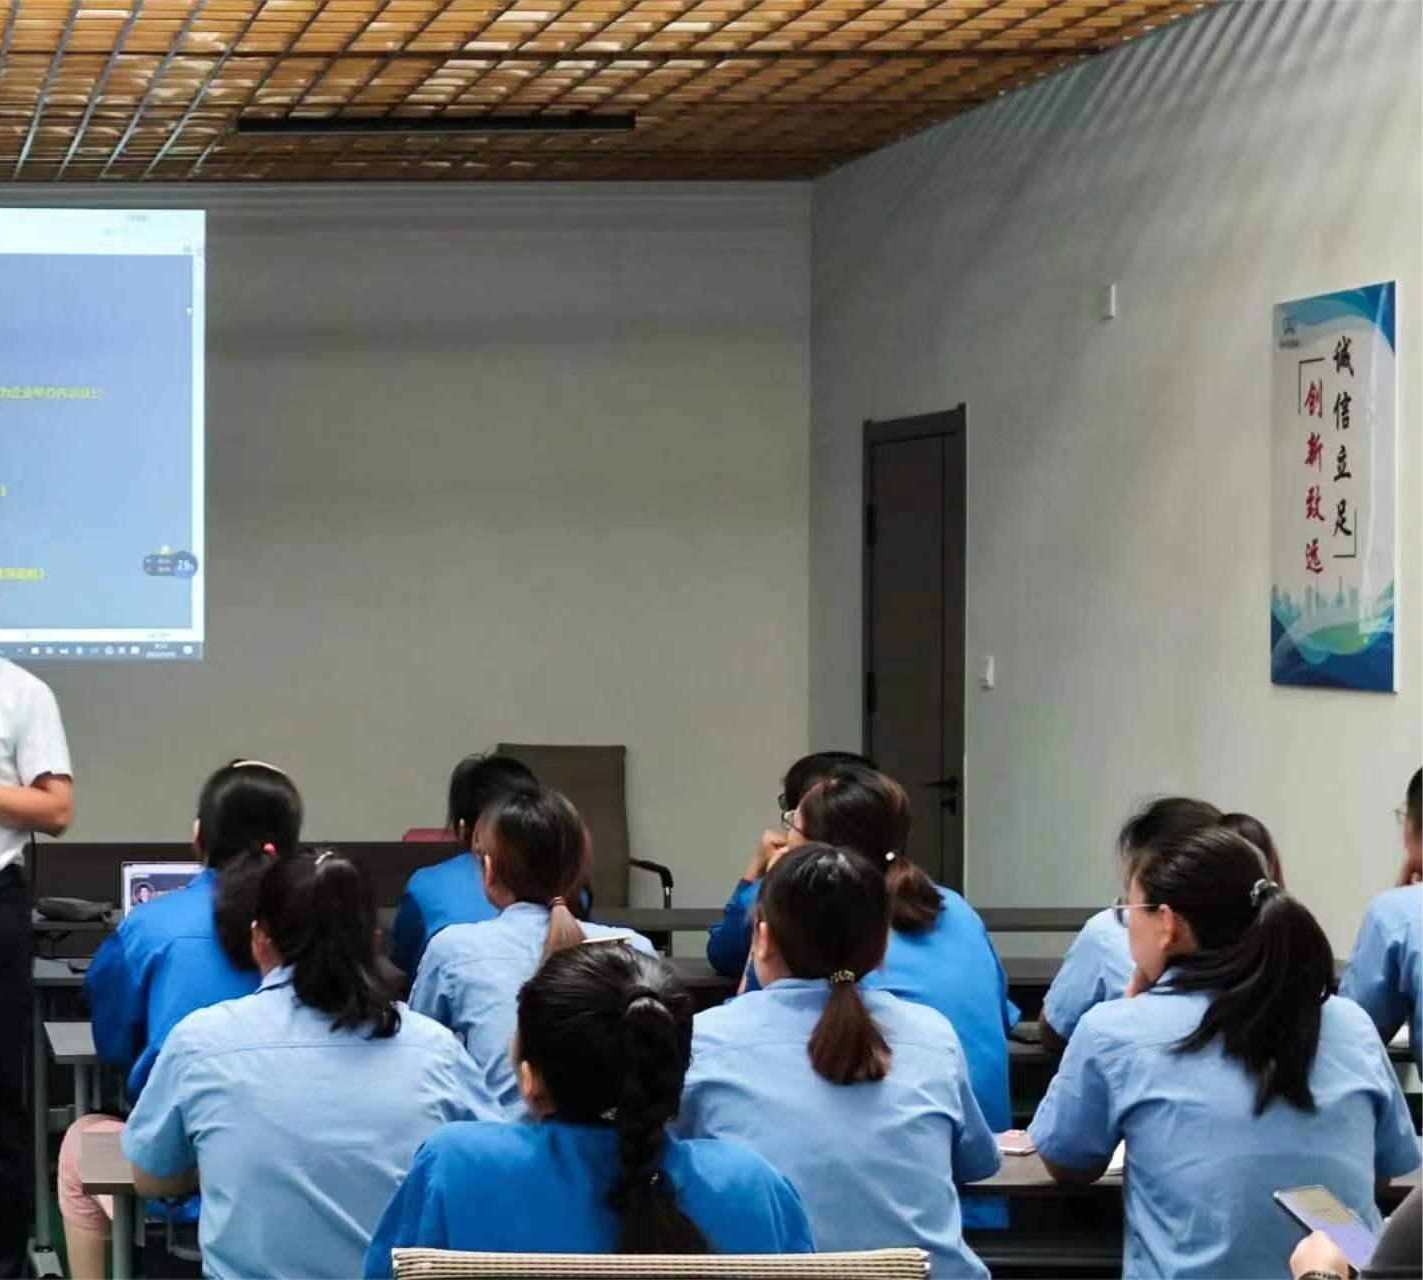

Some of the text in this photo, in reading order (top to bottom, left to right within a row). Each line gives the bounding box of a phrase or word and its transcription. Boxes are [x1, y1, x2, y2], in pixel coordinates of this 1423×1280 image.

[1304, 378, 1325, 574] 创新致远
[1333, 335, 1354, 537] 诚信立足
